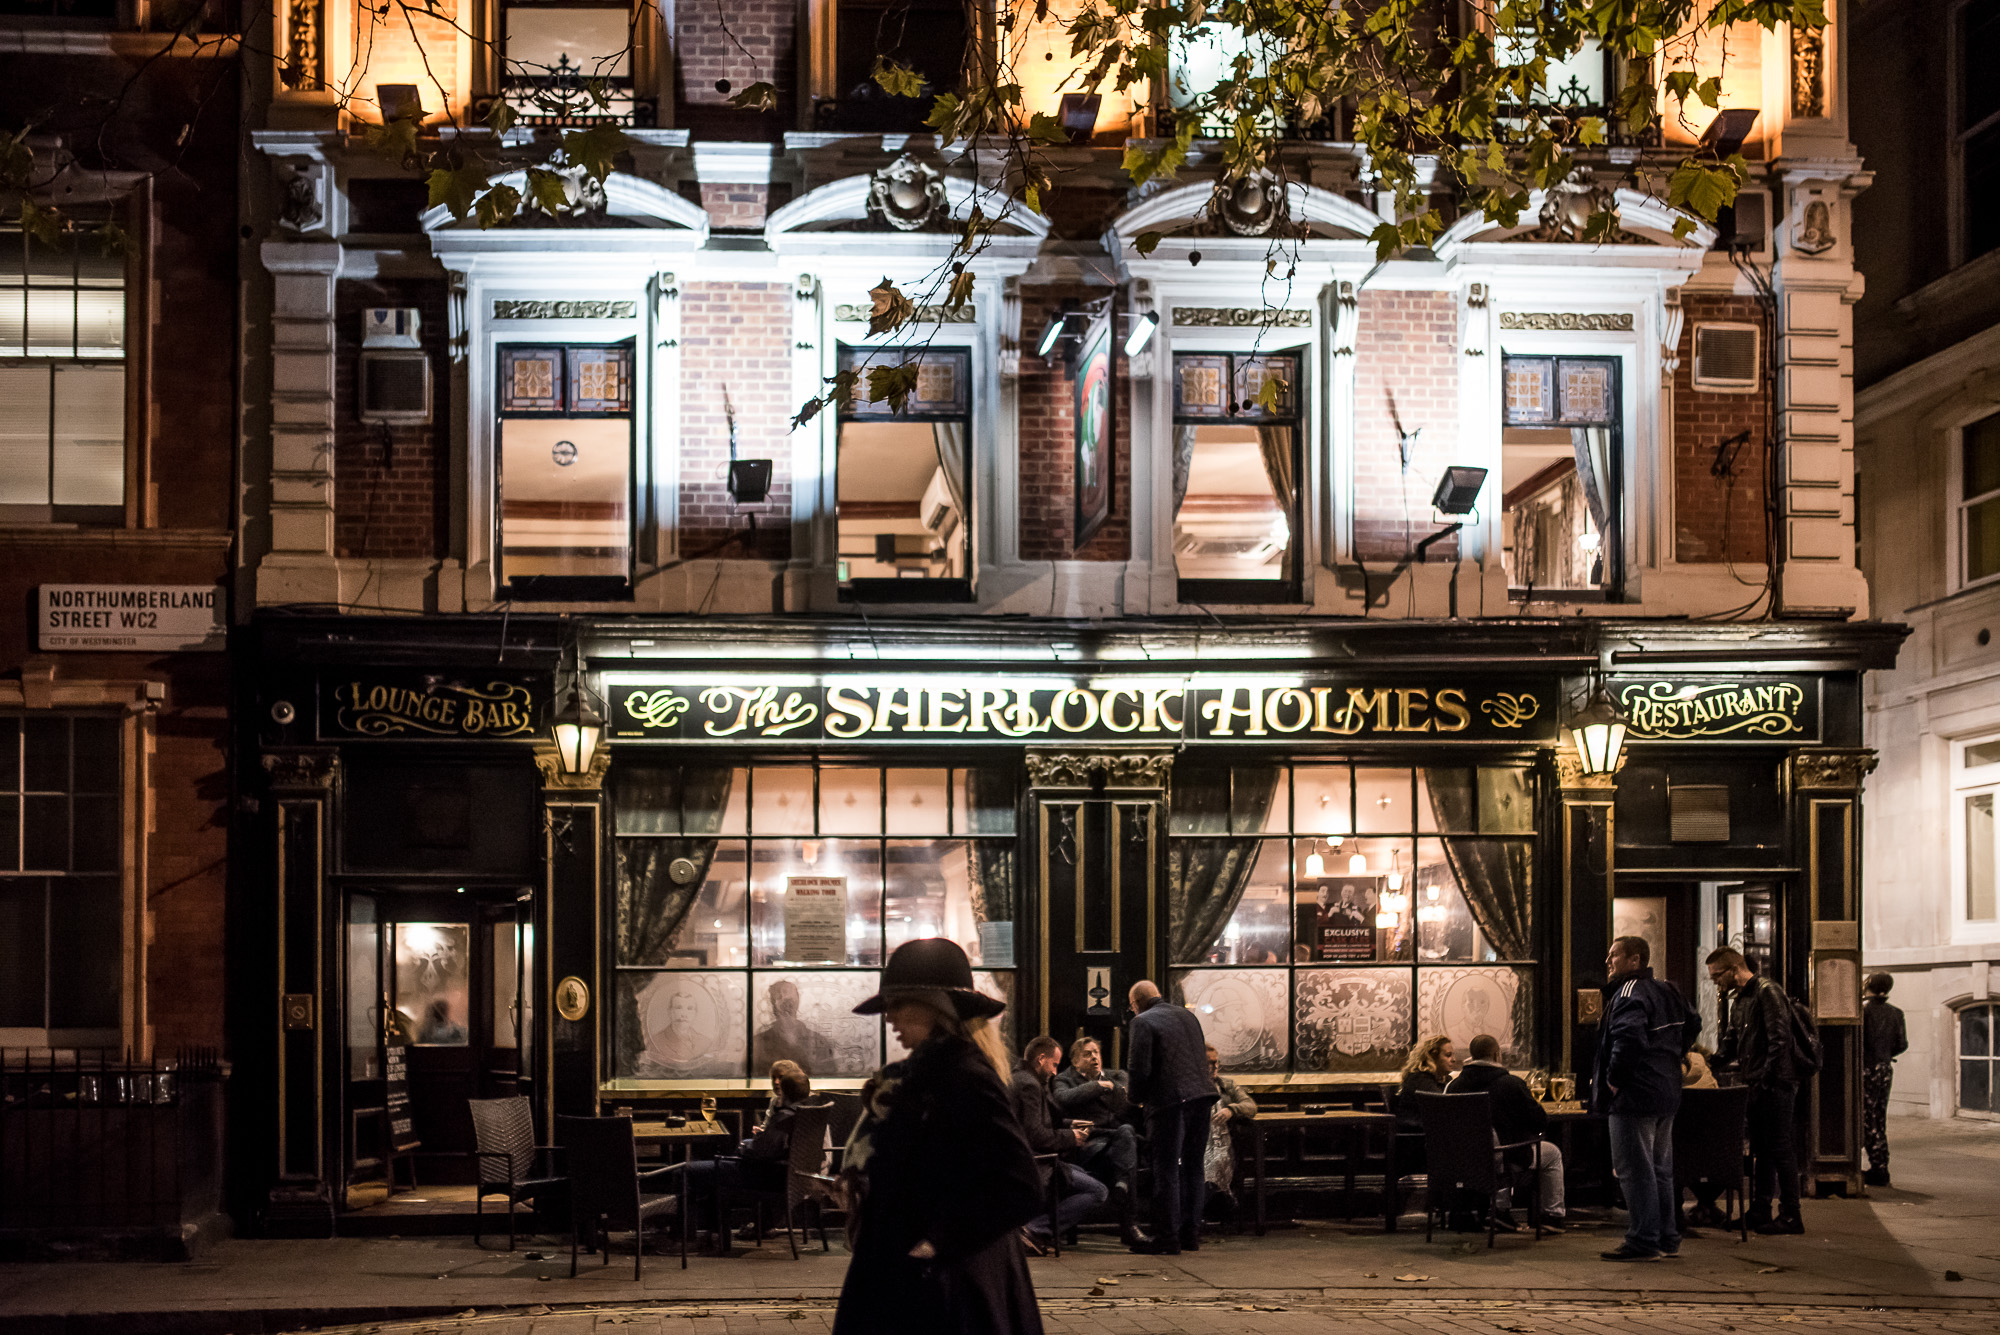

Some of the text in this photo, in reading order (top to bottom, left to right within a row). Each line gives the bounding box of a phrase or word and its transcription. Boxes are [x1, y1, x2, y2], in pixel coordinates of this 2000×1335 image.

[49, 590, 215, 609] NORTHUMBERLAND
[49, 611, 157, 628] STREET WC2
[49, 637, 136, 646] CITY OF WESTMINSTER
[351, 682, 522, 734] LOUNGE BAR
[699, 684, 1471, 738] The SHERLOCK HOLMES
[1631, 685, 1792, 732] RESTAURANT
